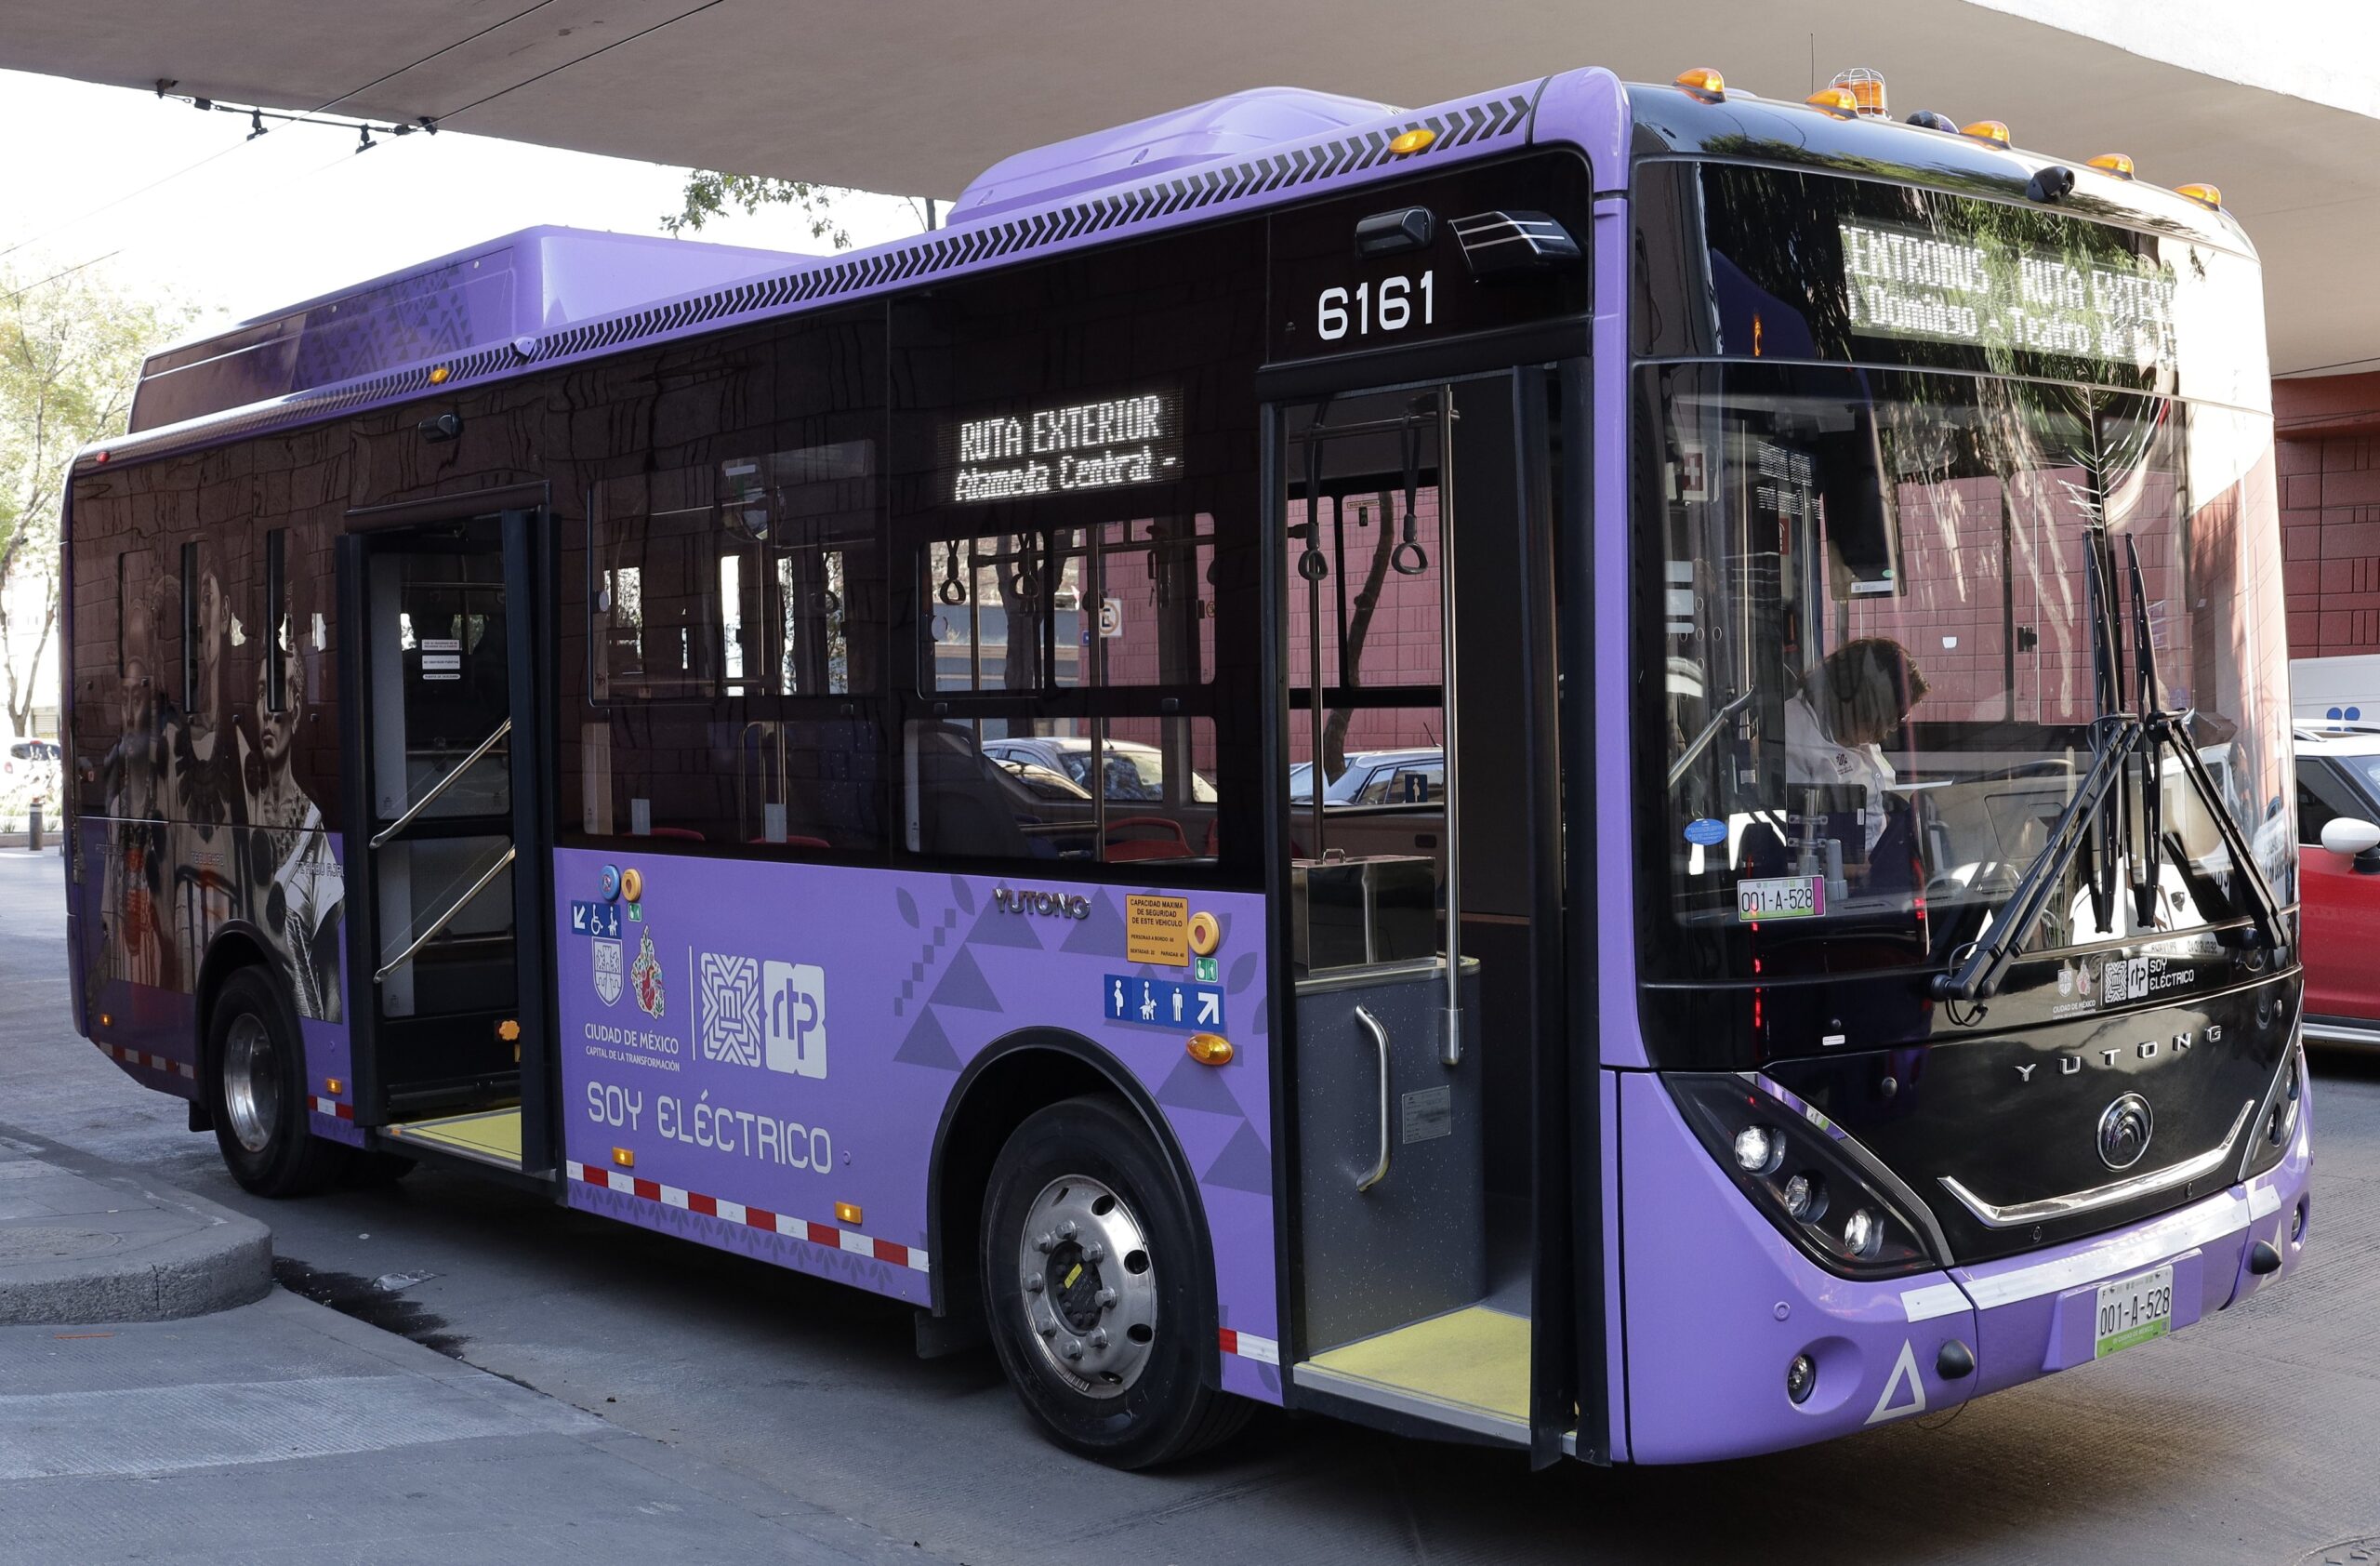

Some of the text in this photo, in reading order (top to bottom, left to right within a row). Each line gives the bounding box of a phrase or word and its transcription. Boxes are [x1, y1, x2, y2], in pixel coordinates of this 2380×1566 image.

[1318, 270, 1433, 340] 6161
[961, 395, 1160, 461] RUTA EXTERIOR
[955, 460, 1050, 501] Alameda
[1060, 445, 1151, 489] Central
[993, 889, 1091, 920] YUTONG
[1130, 898, 1183, 909] CAPACIDAD MAXIMA
[1145, 909, 1177, 918] SEGURIDAD
[1741, 888, 1813, 912] 001-A-528
[1141, 917, 1154, 925] ESTE
[1155, 919, 1183, 927] VEHICULO
[2149, 958, 2168, 974] SOY
[2149, 969, 2194, 990] ELÉCTRICO
[2053, 1003, 2070, 1014] CIUDAD
[585, 1023, 680, 1055] CIUDAD DE MÉXICO
[2014, 1025, 2223, 1082] YUTONG
[586, 1045, 681, 1072] CAPITAL DE LA TRANSFORMACIÓN
[587, 1082, 833, 1174] SOY ELÉCTRICO
[2100, 1285, 2171, 1336] 001-A-528
